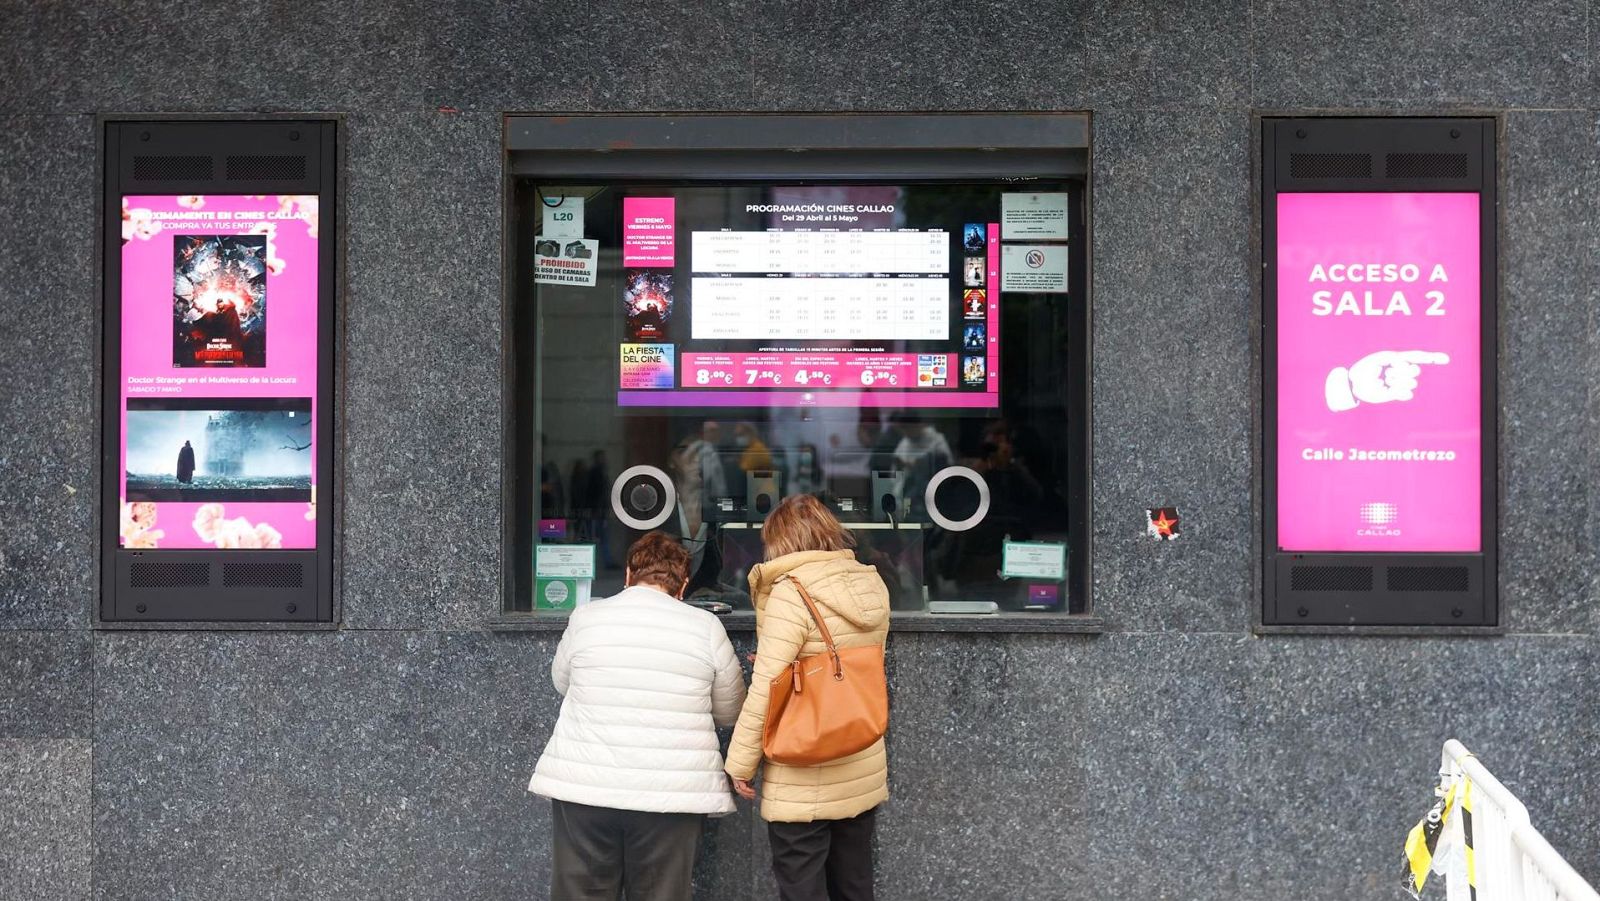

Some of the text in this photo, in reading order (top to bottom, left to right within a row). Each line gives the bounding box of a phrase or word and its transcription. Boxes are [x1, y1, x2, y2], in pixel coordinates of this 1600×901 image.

[746, 203, 894, 213] PROGRAMACIÓN CINES CALLAO
[217, 211, 231, 220] EN
[234, 211, 265, 220] CINES
[267, 211, 308, 220] CALLAO
[553, 213, 574, 221] L20
[782, 214, 794, 222] Del
[838, 215, 858, 223] Mayo
[163, 222, 200, 230] COMPRA
[540, 259, 586, 269] PROHIBIDO
[1308, 263, 1448, 282] ACCESO A
[1311, 290, 1446, 316] SALA 2
[128, 376, 154, 384] Doctor
[156, 376, 186, 385] Strange
[199, 376, 207, 384] el
[208, 376, 248, 384] Multiverso
[250, 376, 260, 384] de
[261, 376, 269, 384] la
[270, 376, 297, 384] Locura
[1301, 447, 1456, 461] Calle Jacometrezo
